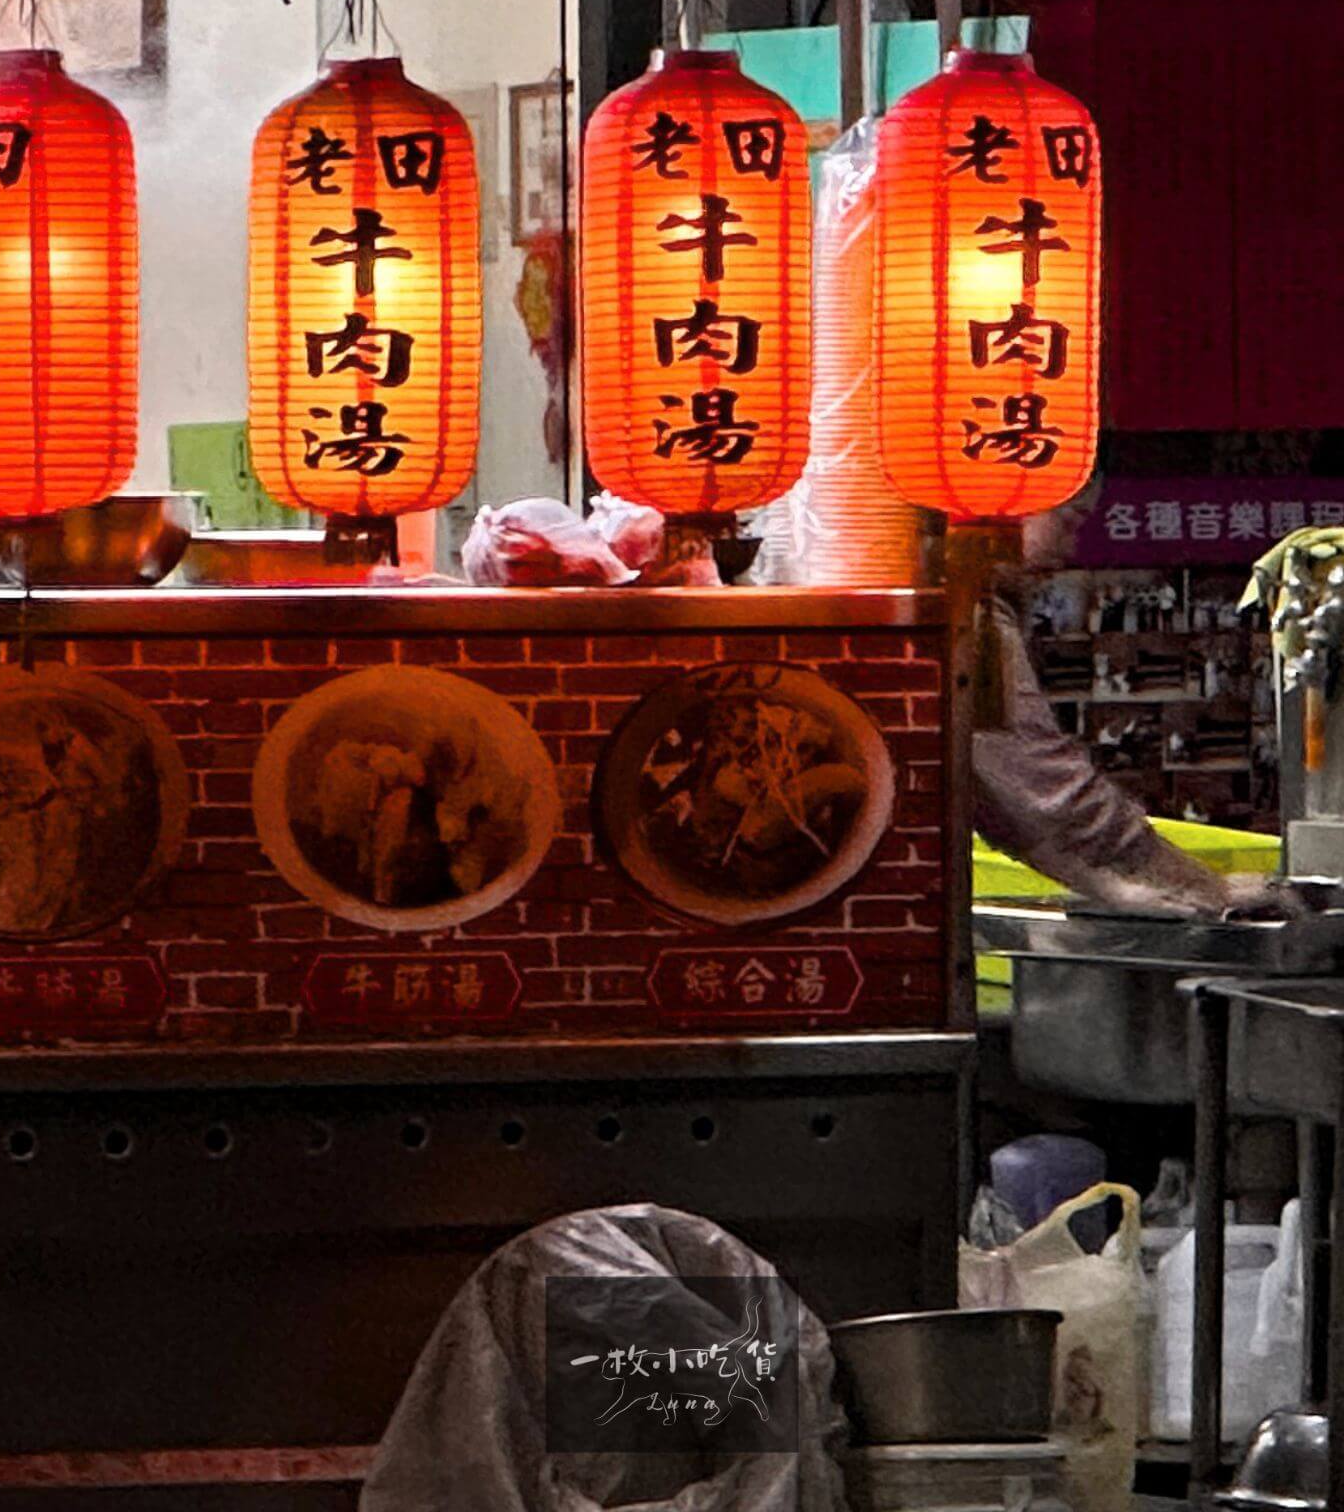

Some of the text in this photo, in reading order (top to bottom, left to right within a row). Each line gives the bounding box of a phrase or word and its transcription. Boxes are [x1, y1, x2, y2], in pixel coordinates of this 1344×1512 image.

[286, 128, 446, 195] 老田
[631, 111, 786, 183] 老田
[945, 114, 1098, 189] 老田
[301, 208, 415, 478] 牛肉湯
[651, 194, 763, 467] 牛肉湯
[961, 197, 1071, 465] 牛肉湯
[685, 954, 828, 1005] 綜合湯
